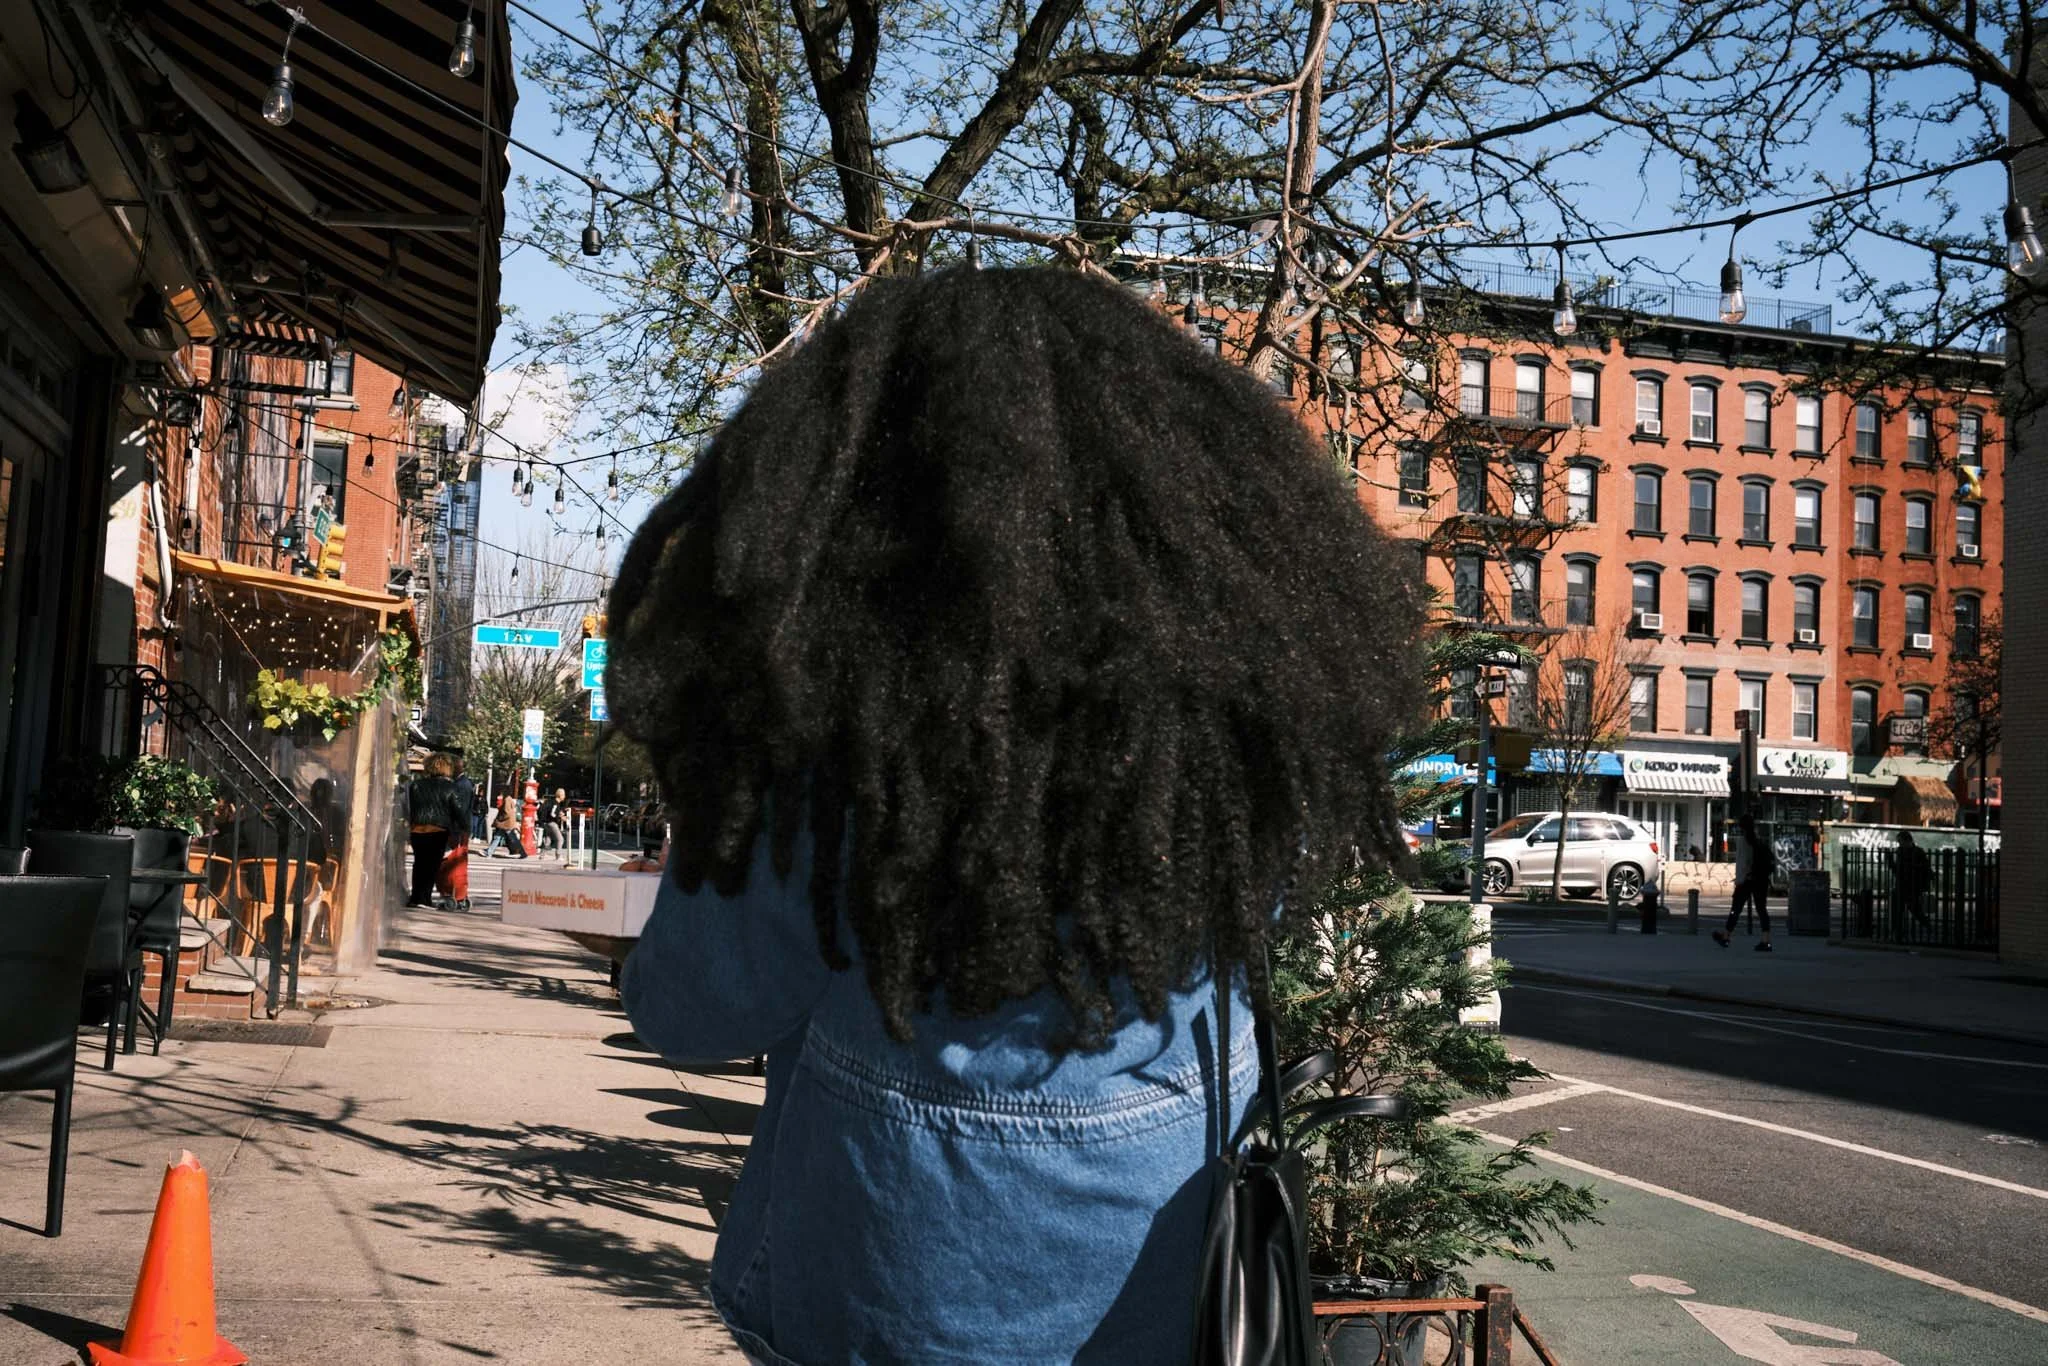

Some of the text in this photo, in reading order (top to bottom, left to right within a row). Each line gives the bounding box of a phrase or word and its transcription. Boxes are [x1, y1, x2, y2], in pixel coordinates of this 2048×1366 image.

[504, 631, 509, 642] 1
[1644, 761, 1721, 774] KOKO WINGS
[1784, 751, 1836, 770] Juice
[534, 889, 569, 908] Macaroni
[569, 893, 577, 909] &
[577, 893, 605, 912] Cheese
